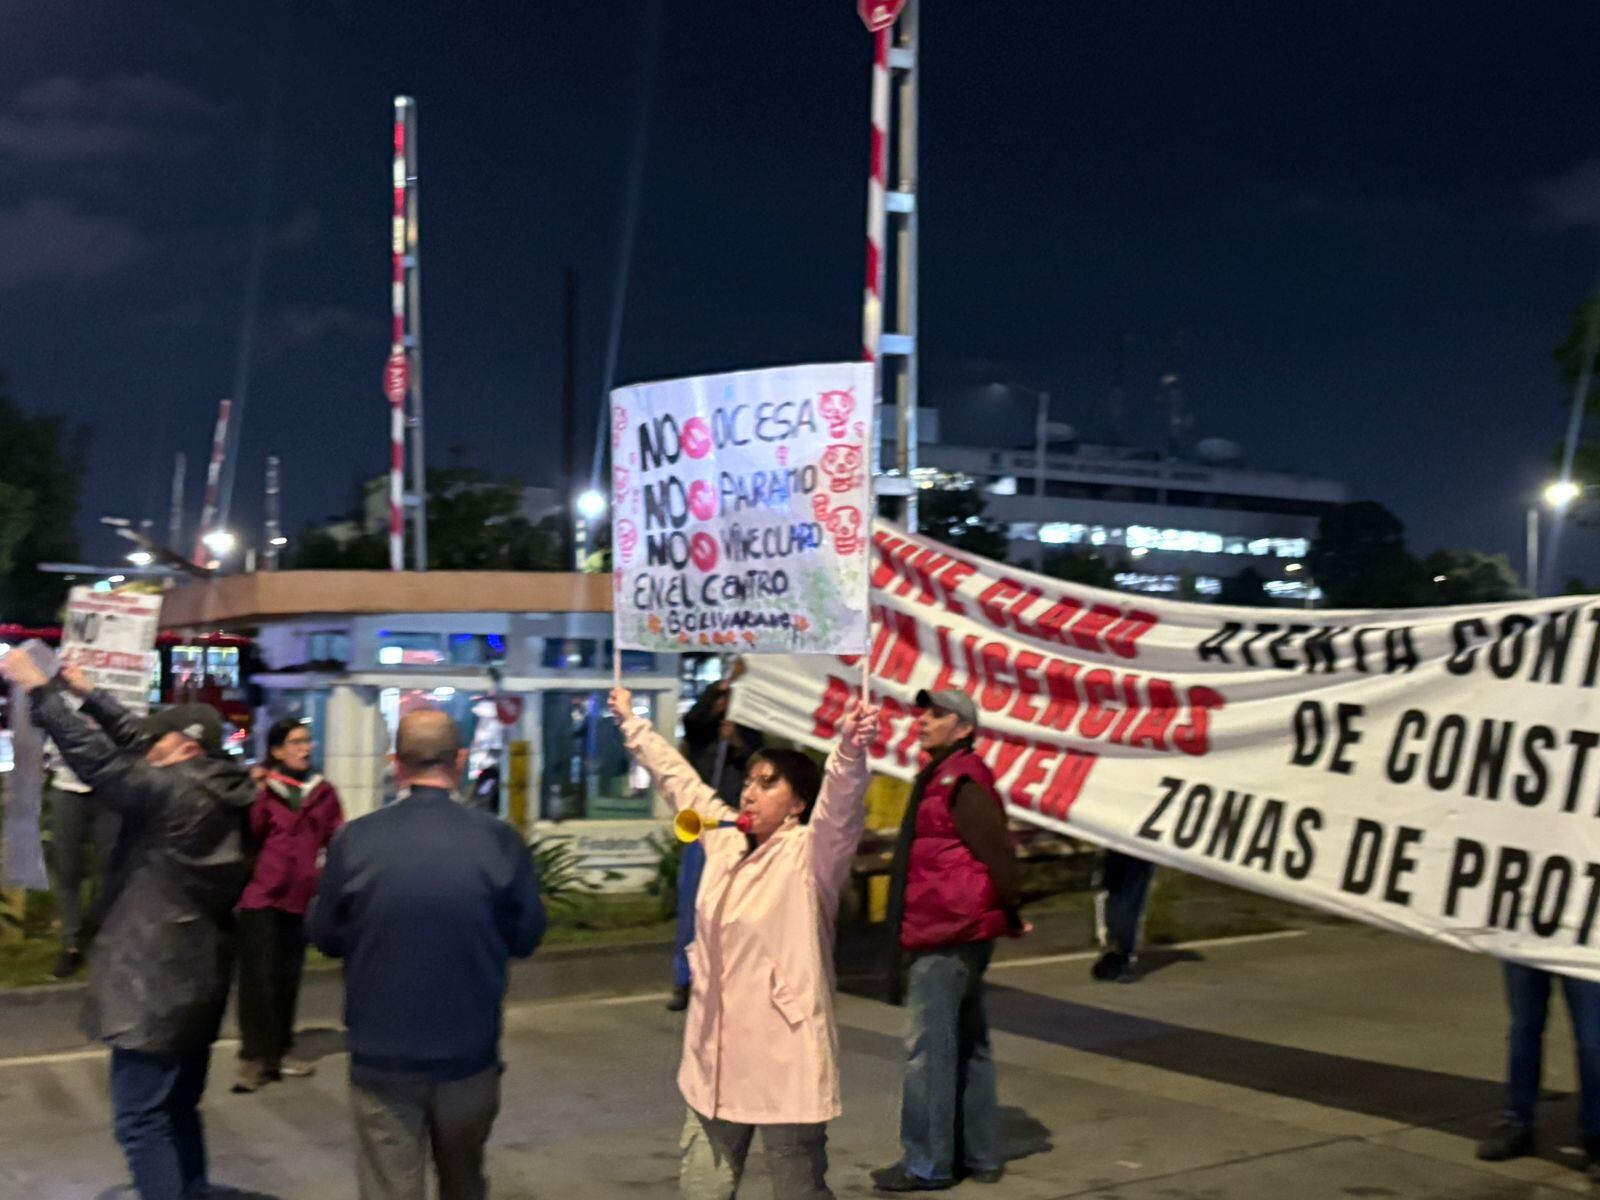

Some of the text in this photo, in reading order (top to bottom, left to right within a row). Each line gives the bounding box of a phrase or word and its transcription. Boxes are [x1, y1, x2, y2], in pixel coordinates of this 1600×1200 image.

[639, 398, 817, 472] NO OCESA
[643, 476, 690, 530] NO
[647, 531, 690, 571] NO
[702, 570, 789, 606] CENTRO
[979, 577, 1159, 659] CLARO
[1197, 621, 1421, 673] ATENTA
[931, 626, 1226, 757] LICENCIAS
[1289, 700, 1365, 775] DE
[1387, 709, 1600, 817] CONST
[1138, 777, 1325, 881] ZONAS
[1341, 818, 1425, 906] DE
